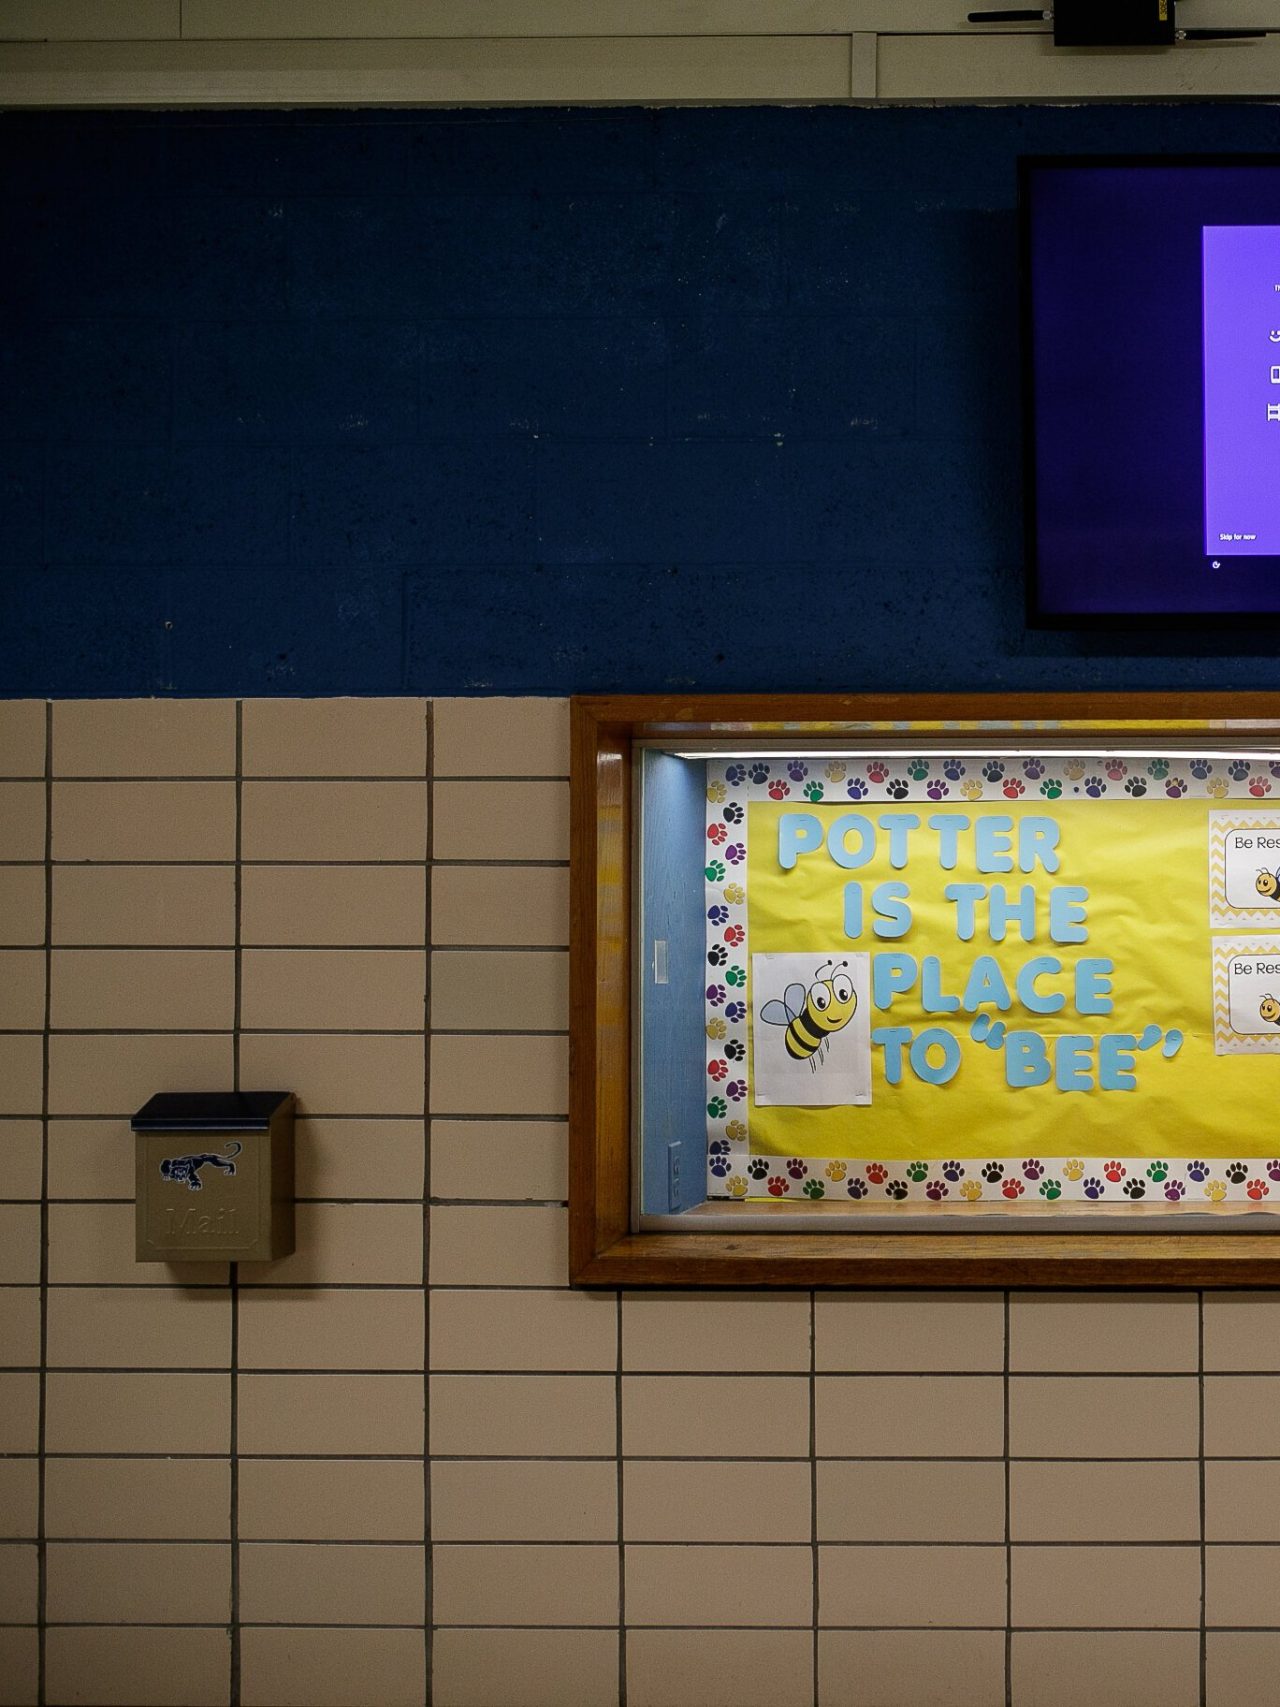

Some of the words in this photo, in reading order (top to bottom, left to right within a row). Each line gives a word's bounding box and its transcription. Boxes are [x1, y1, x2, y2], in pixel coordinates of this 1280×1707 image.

[1220, 533, 1232, 541] Skip
[779, 813, 1060, 873] POTTER
[1235, 836, 1253, 849] Be
[844, 881, 912, 939] IS
[945, 884, 1089, 943] THE
[873, 952, 1114, 1015] PLACE
[1234, 961, 1252, 975] Be
[873, 1027, 962, 1085] TO
